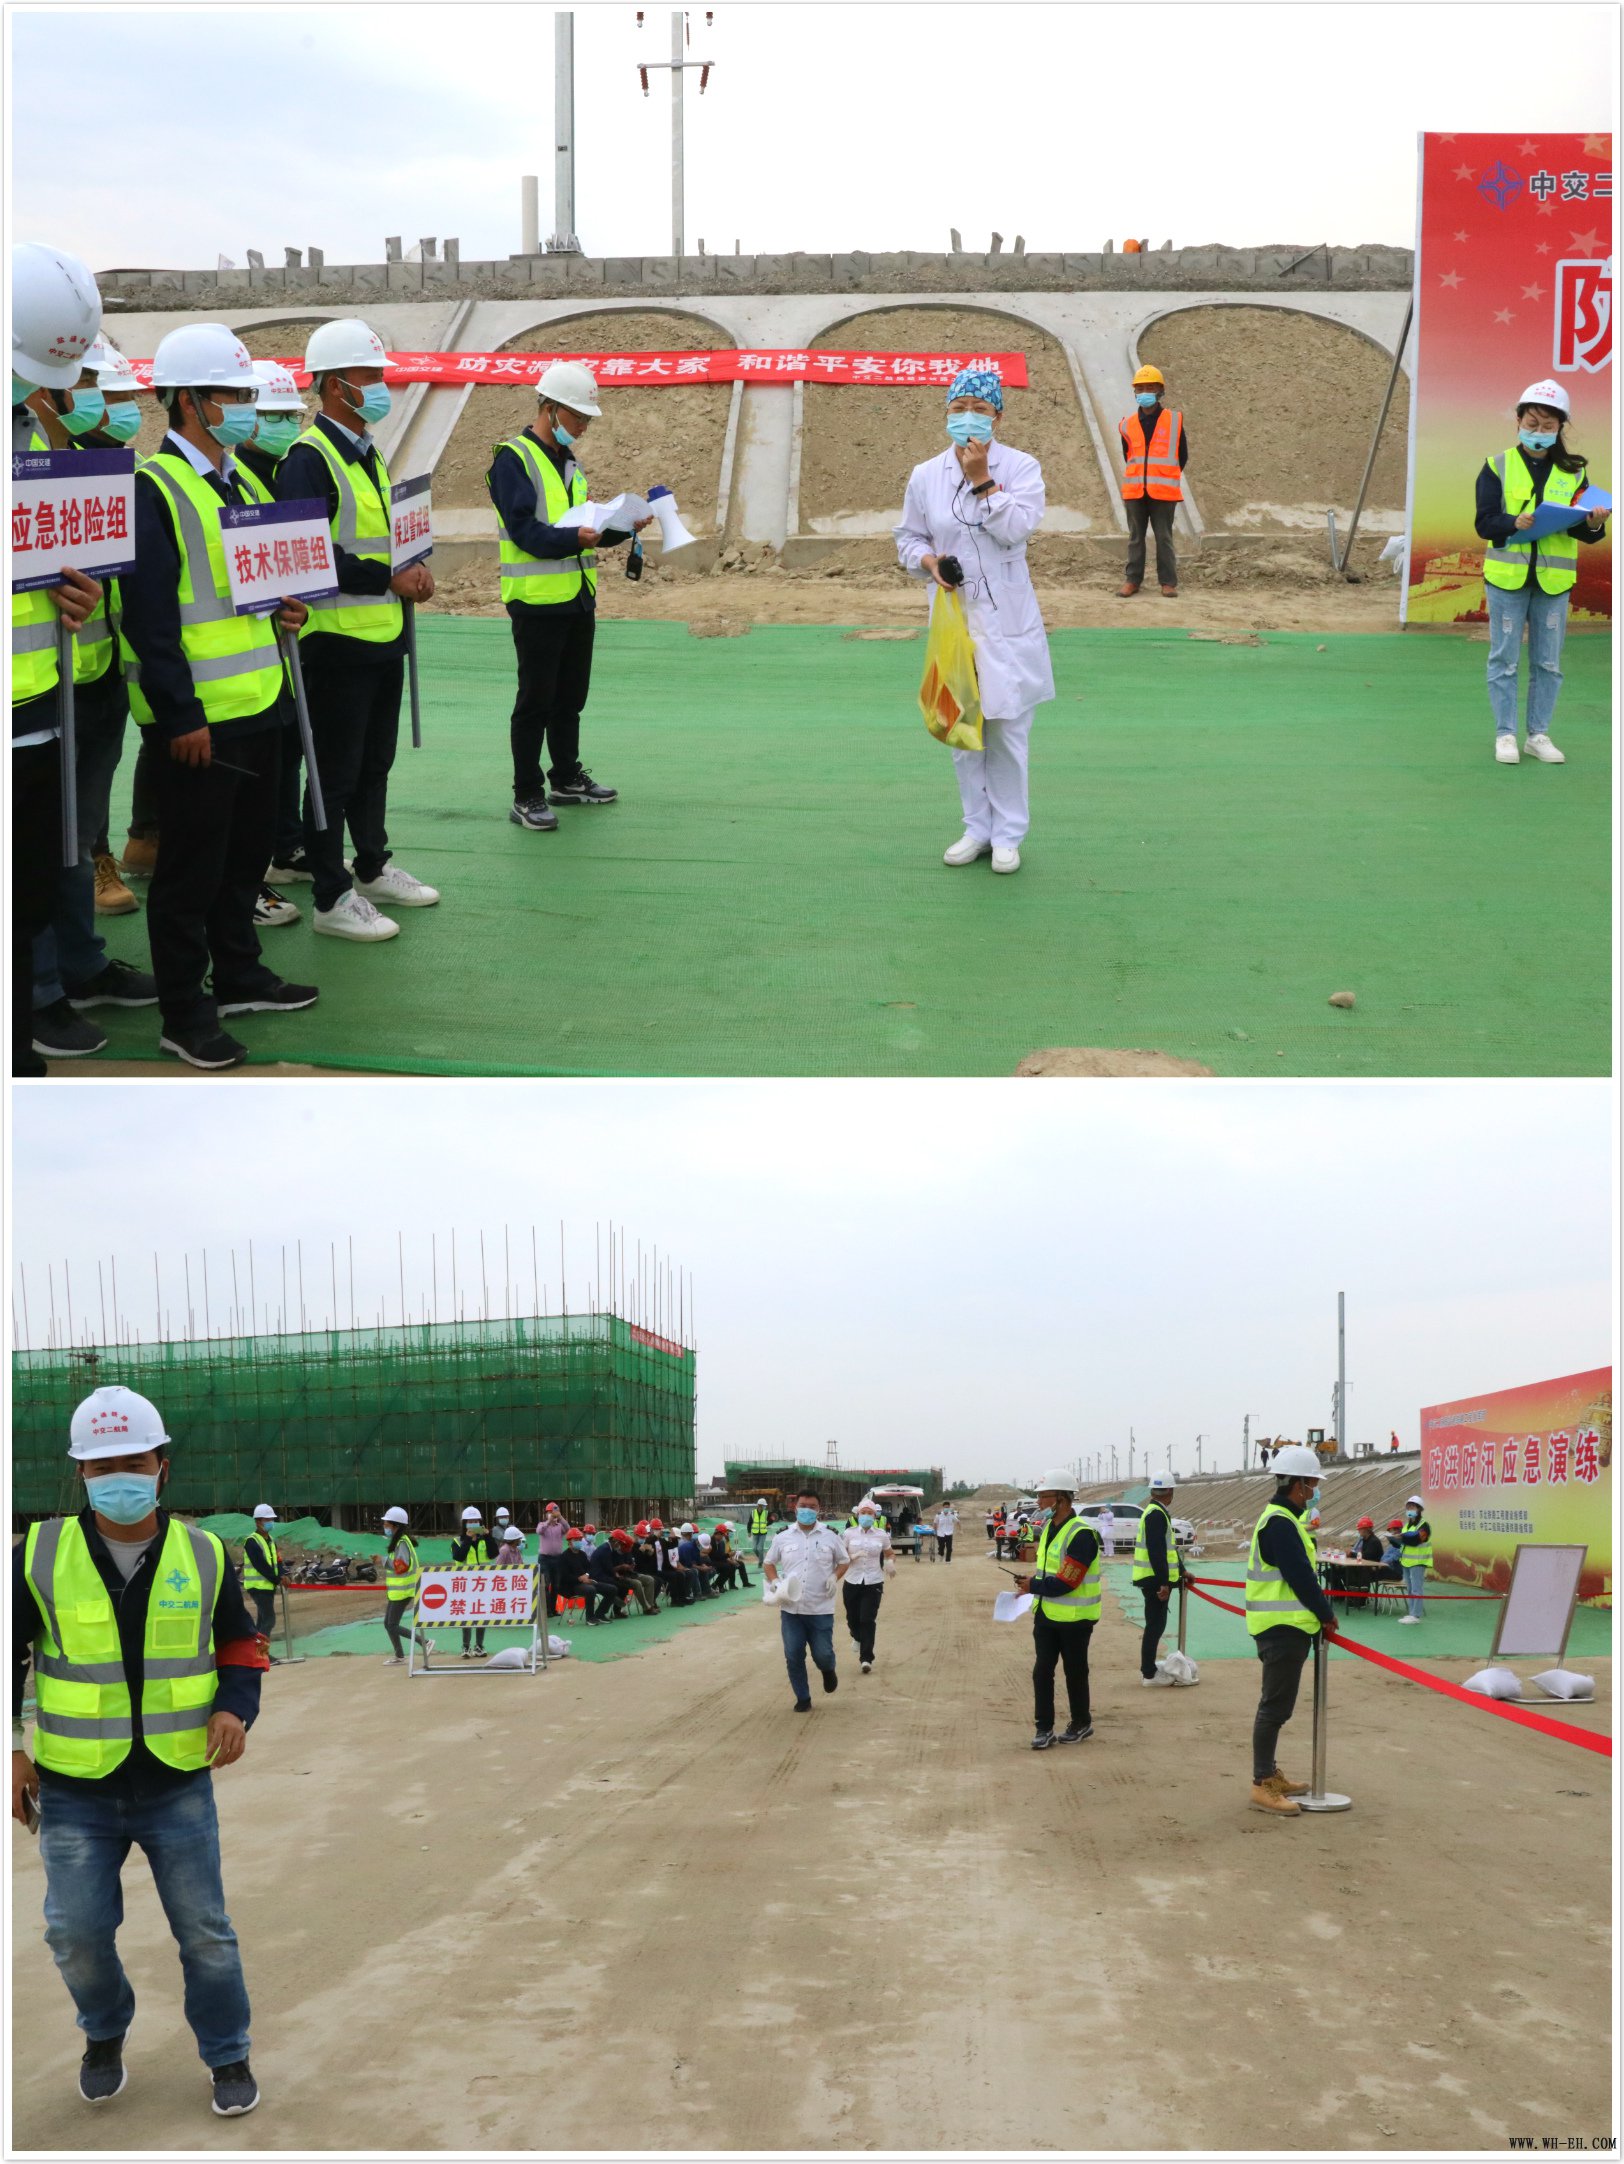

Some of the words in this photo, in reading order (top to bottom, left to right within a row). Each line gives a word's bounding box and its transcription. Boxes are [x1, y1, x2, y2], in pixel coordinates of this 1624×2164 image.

[1531, 171, 1612, 200] 中交二
[736, 353, 1004, 376] 和谐平安你我他
[25, 458, 51, 467] 中国交建
[12, 496, 128, 552] 应急抢险组
[234, 535, 330, 585] 技术保障组
[1429, 1430, 1599, 1488] 防洪防汛应急演练
[451, 1574, 528, 1593] 前方危险
[159, 1600, 199, 1609] 中交二航局
[450, 1597, 528, 1616] 禁止通行
